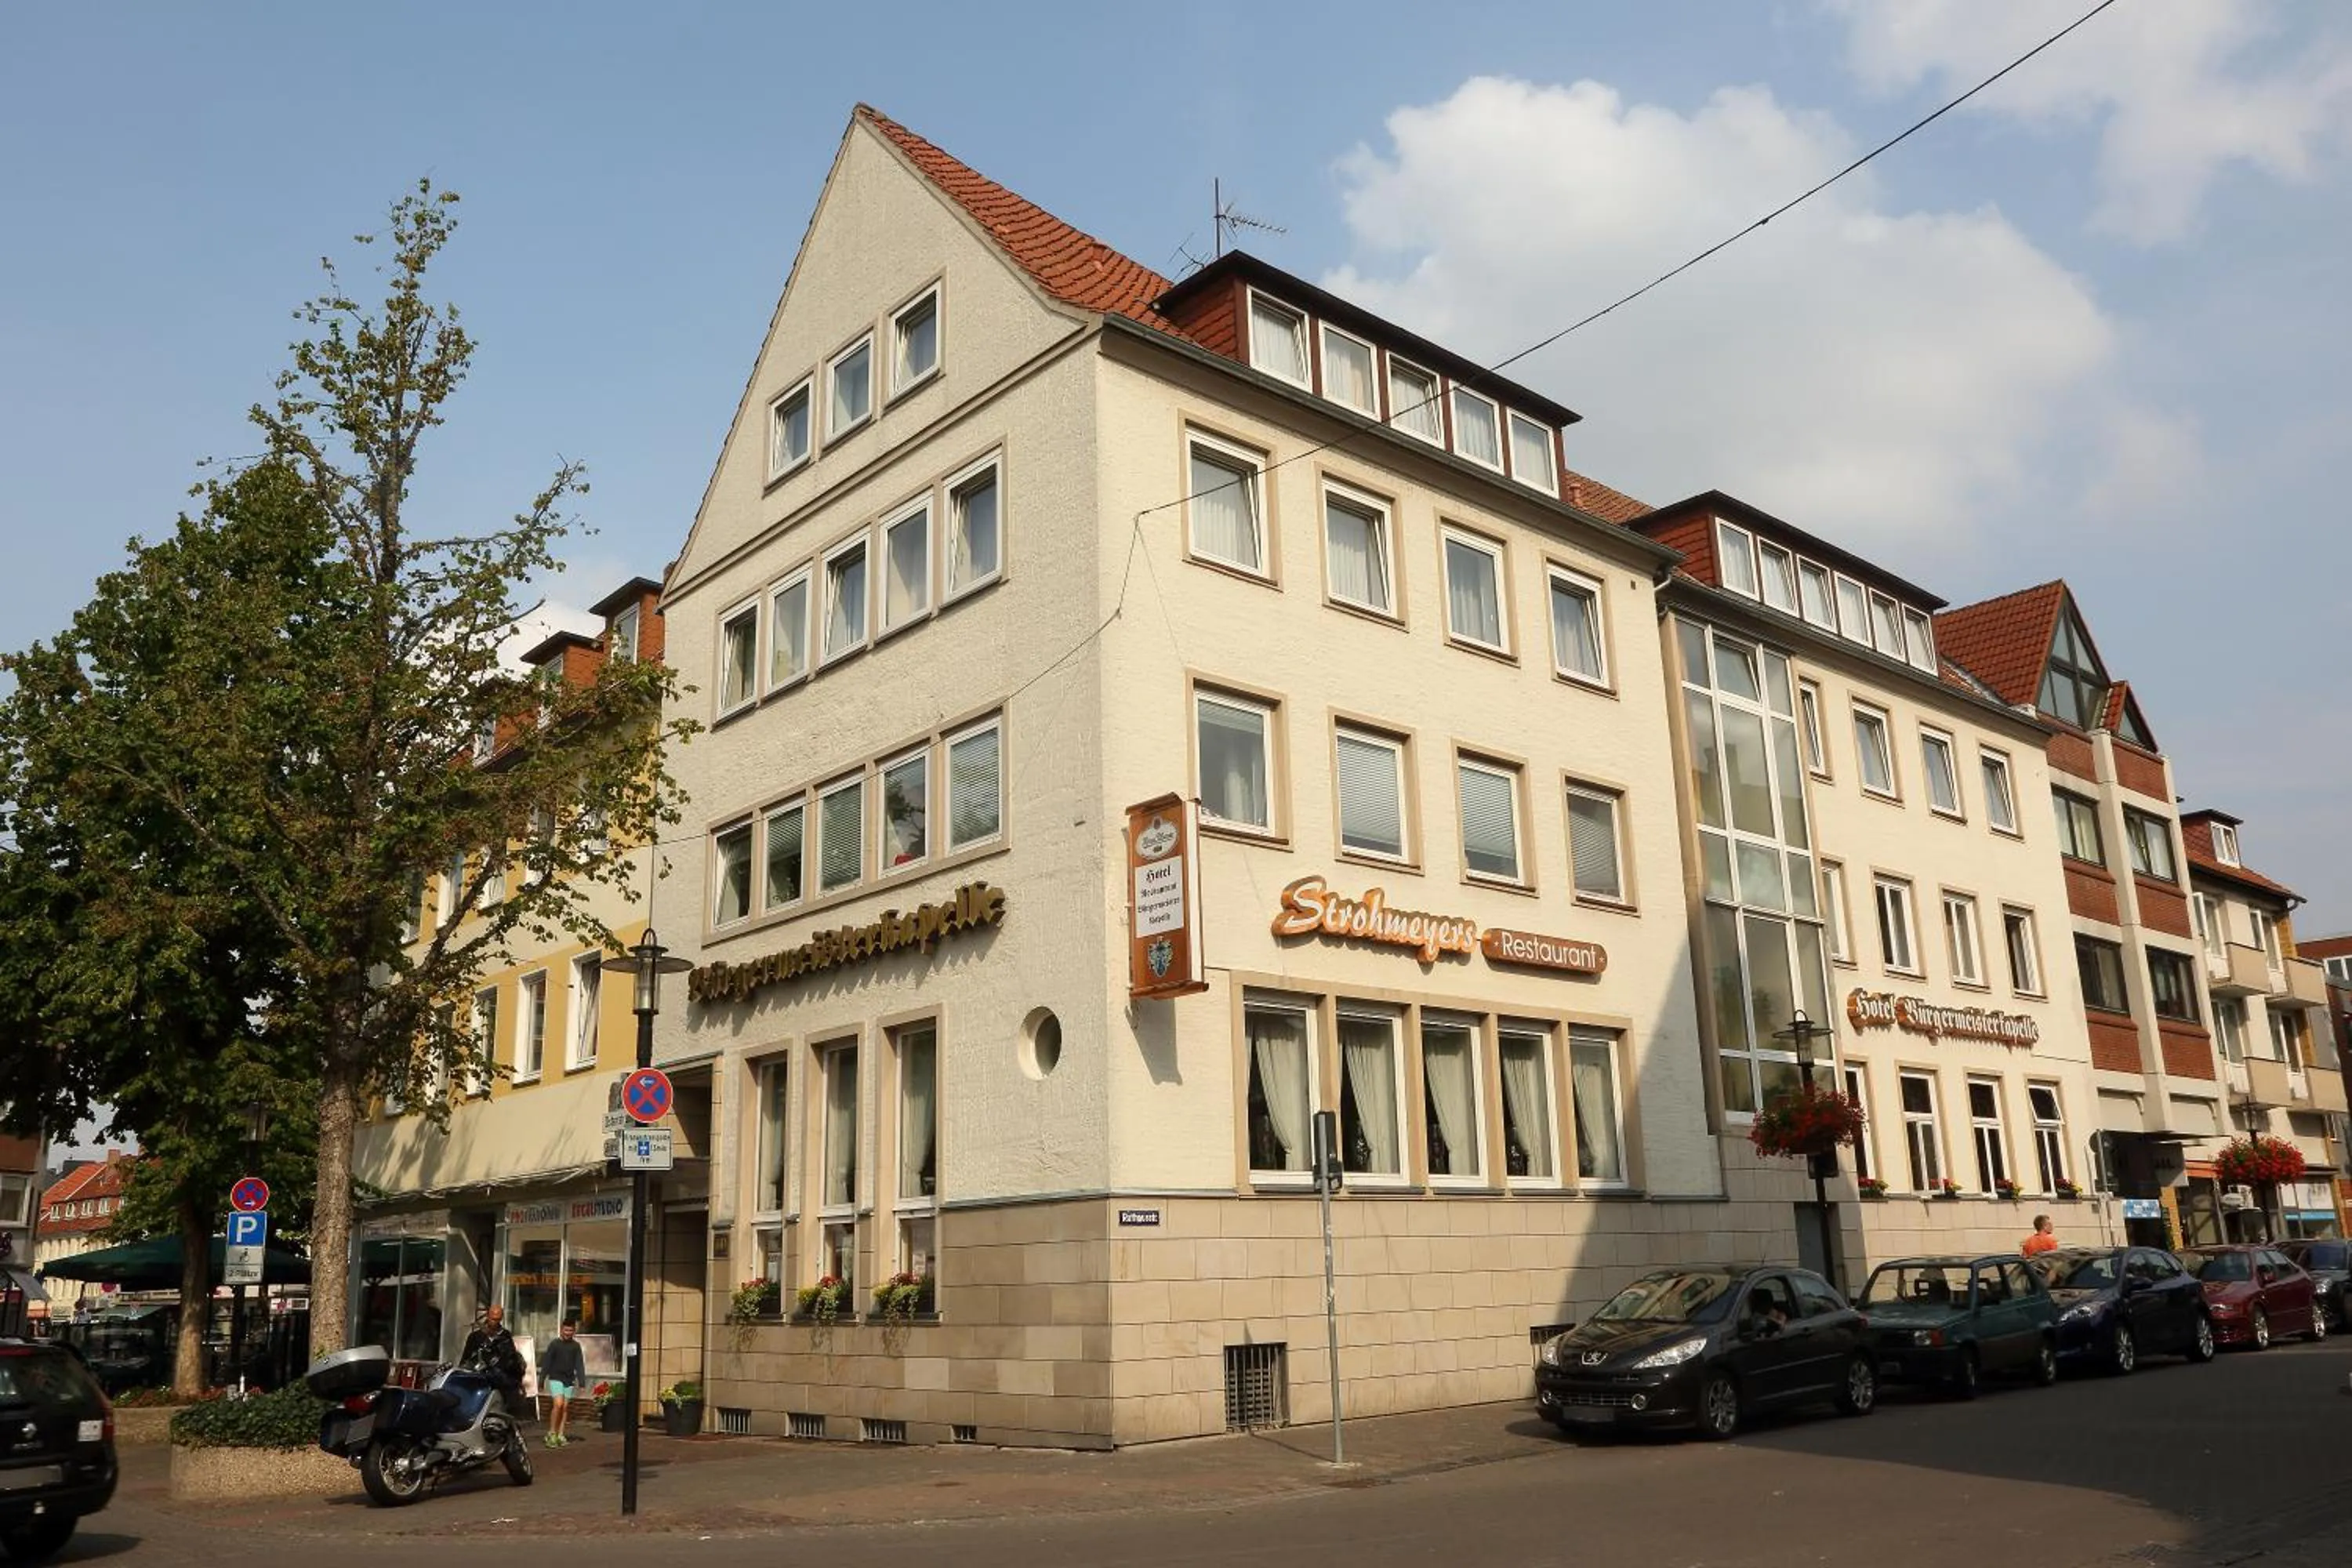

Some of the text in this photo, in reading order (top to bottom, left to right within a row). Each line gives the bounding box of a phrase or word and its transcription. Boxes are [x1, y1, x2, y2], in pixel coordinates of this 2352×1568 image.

[1145, 865, 1171, 883] Hotel
[1284, 877, 1597, 969] Strohmeyers Restaurant
[1854, 989, 1896, 1021] Hotel
[236, 1216, 258, 1243] P
